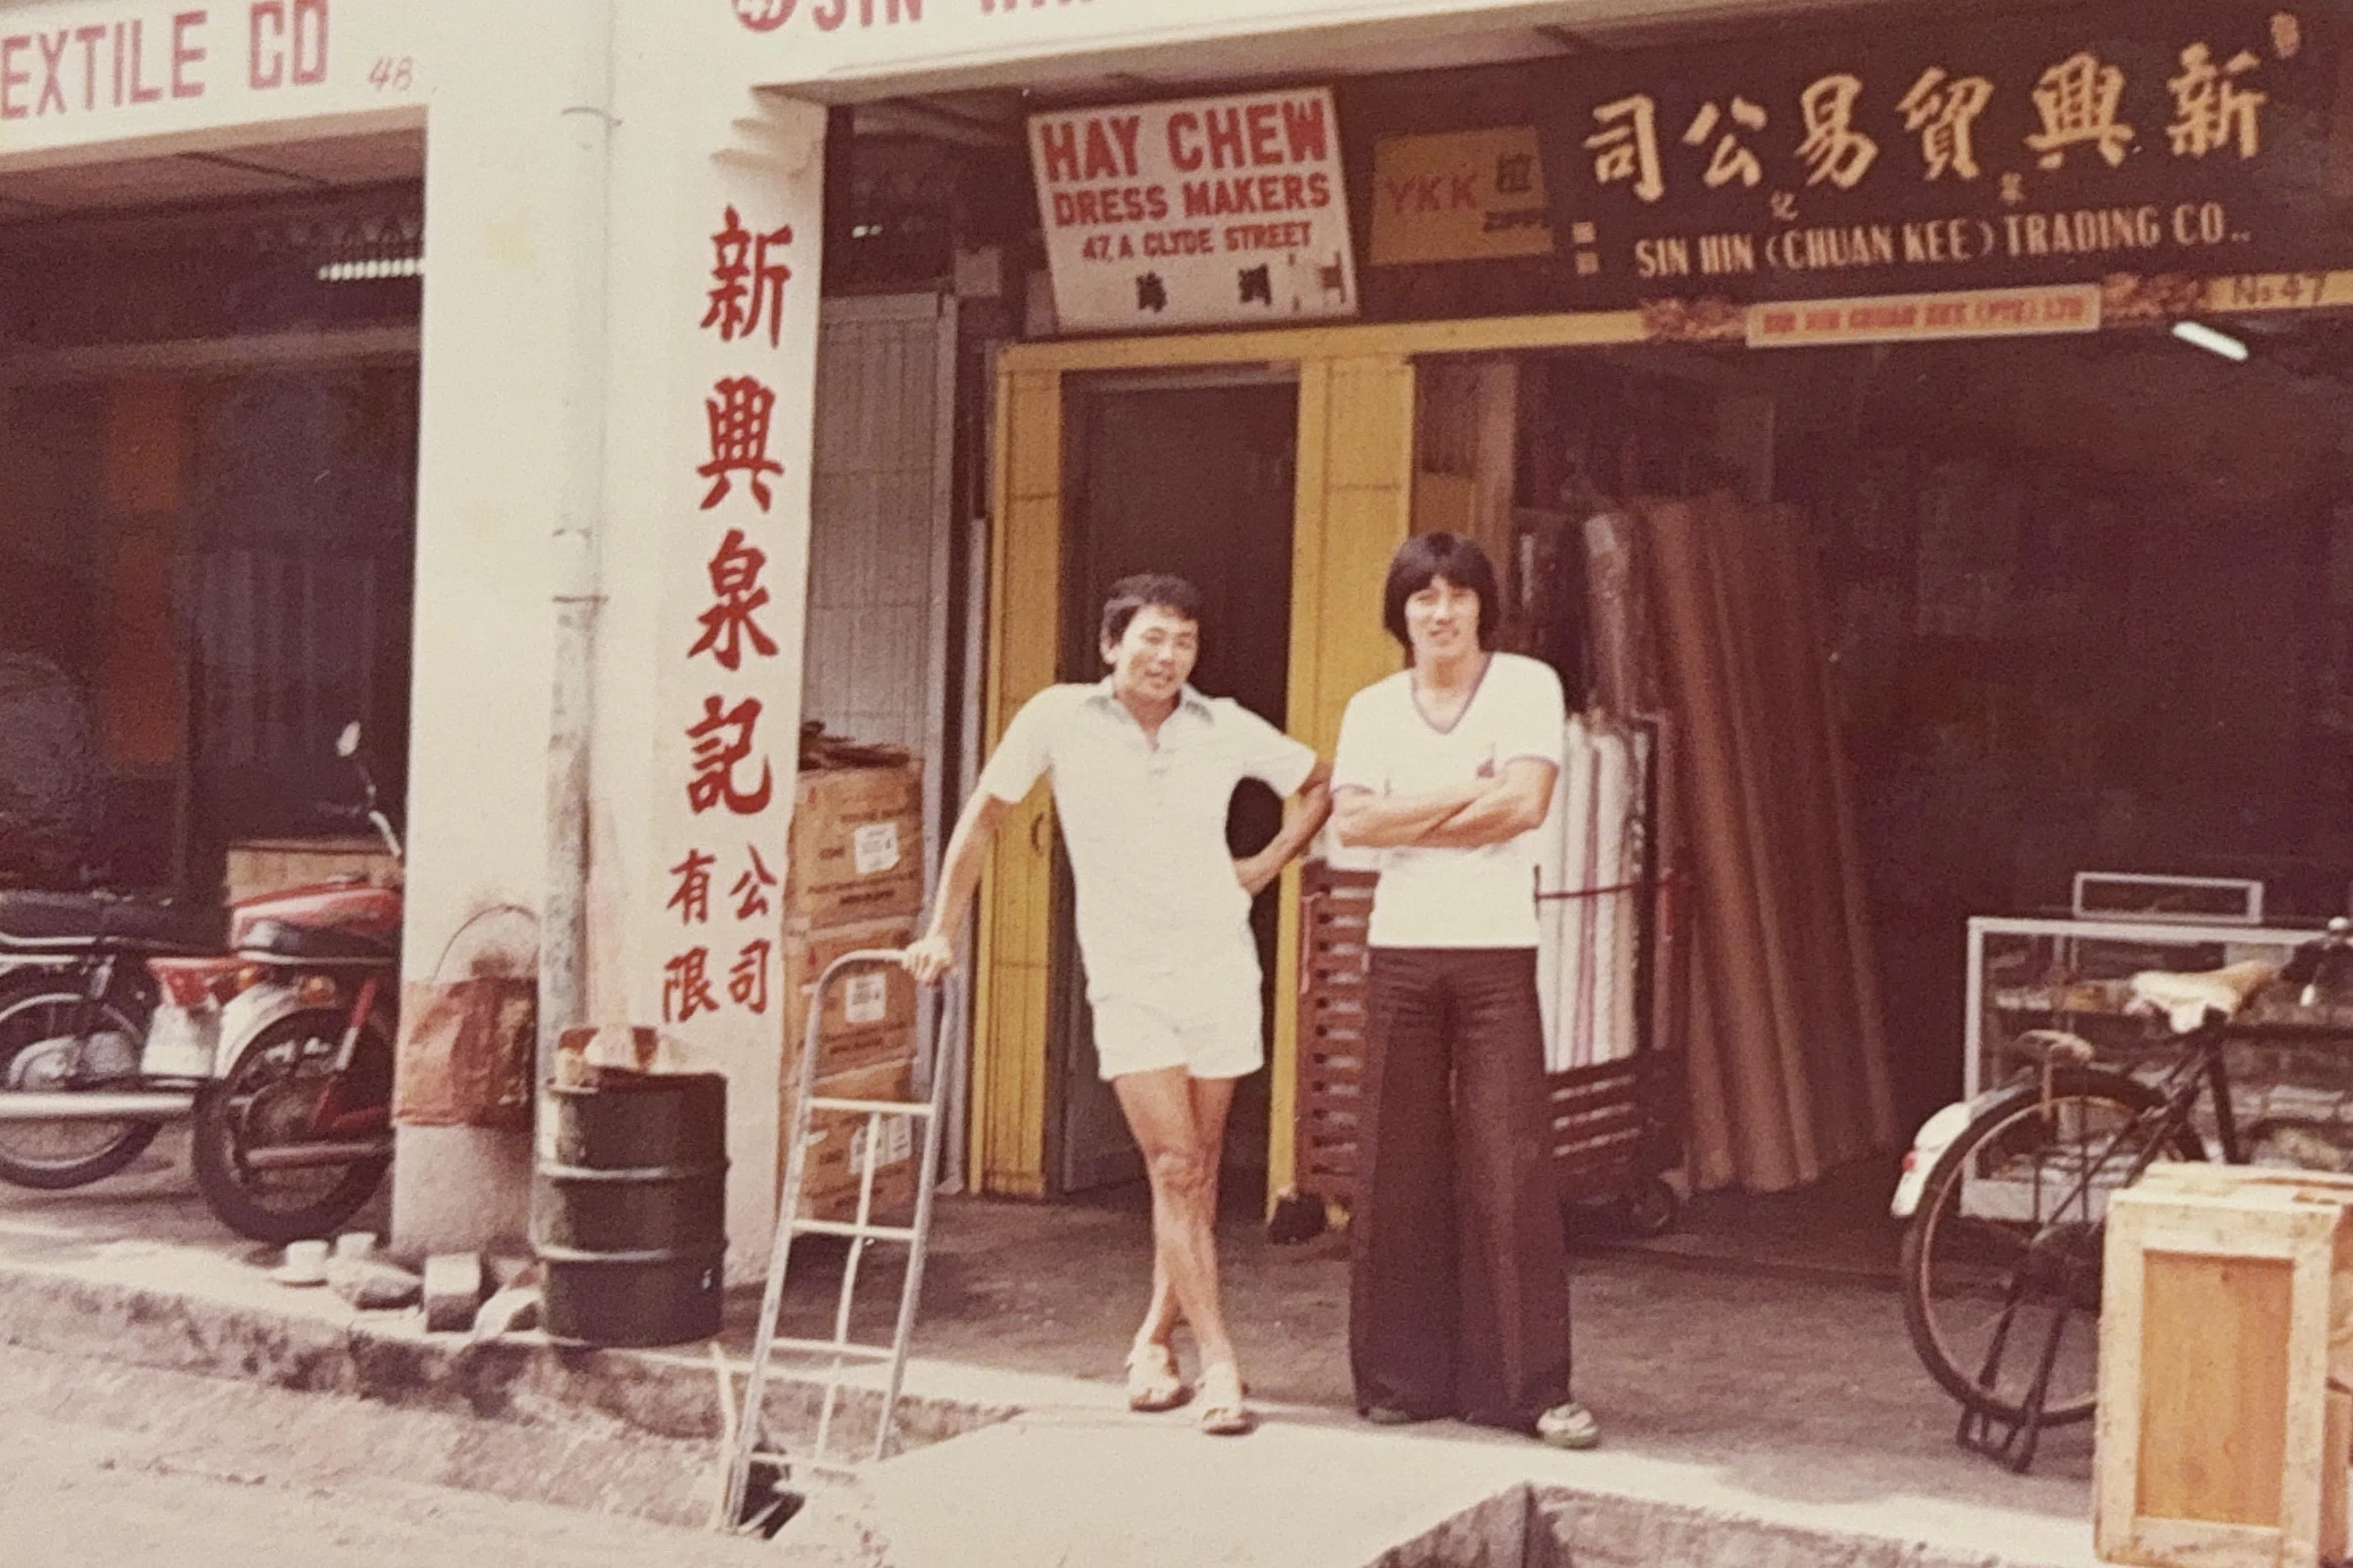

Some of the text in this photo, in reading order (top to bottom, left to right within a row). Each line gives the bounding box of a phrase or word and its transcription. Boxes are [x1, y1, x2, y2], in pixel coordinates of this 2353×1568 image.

[1, 10, 207, 120] EXTILE
[368, 56, 414, 92] 48
[1041, 97, 1326, 183] HAY CHEW
[1051, 171, 1331, 228] DRESS MAKERS
[1143, 226, 1214, 258] CLYDE
[1224, 220, 1312, 252] STREET
[1634, 235, 1689, 278] SIN
[2003, 204, 2161, 257] TRADING
[685, 204, 793, 816] 新興泉記
[662, 848, 720, 1023] 有限
[728, 841, 777, 1015] 公司
